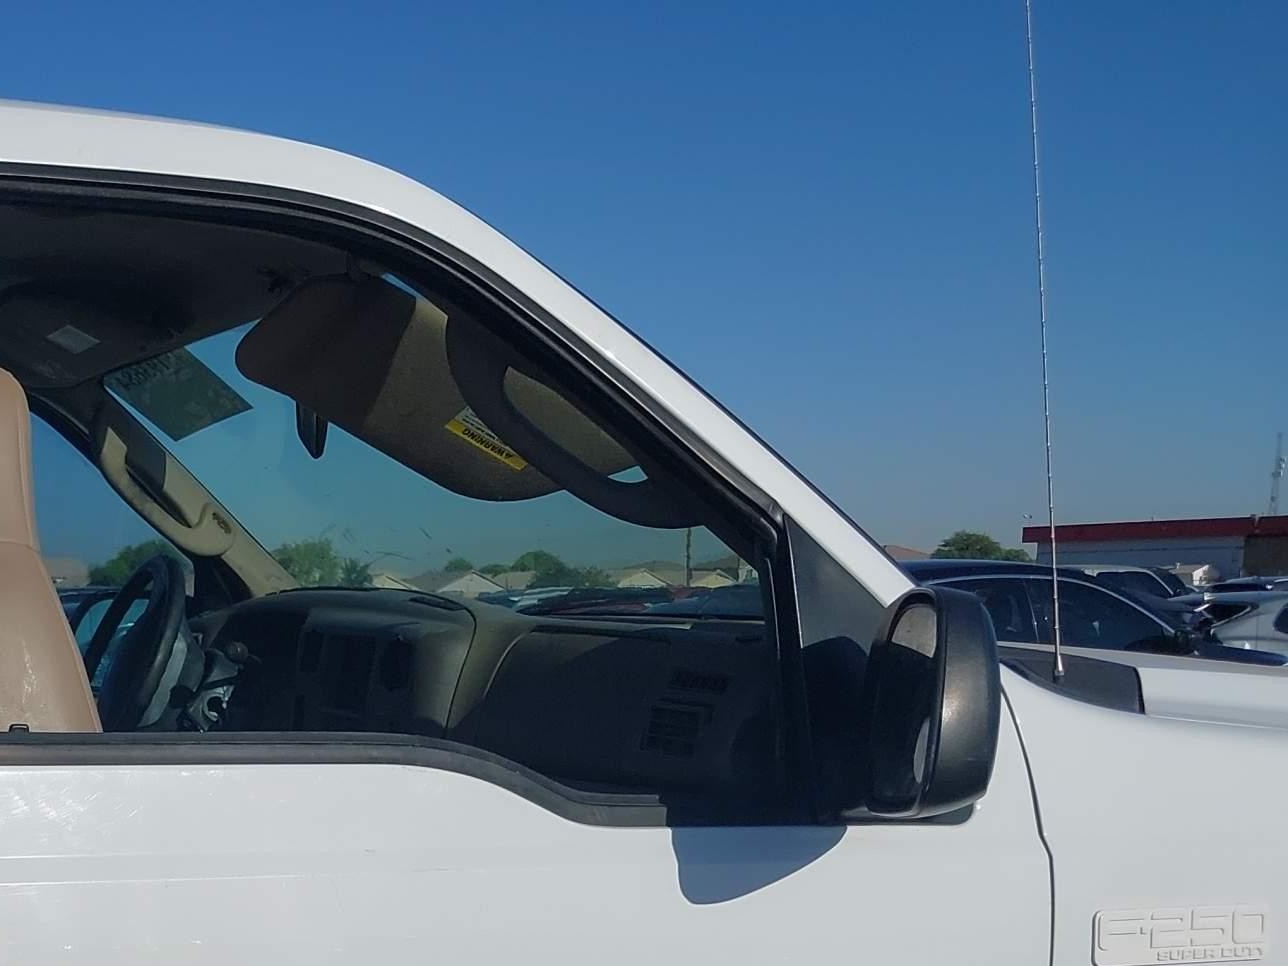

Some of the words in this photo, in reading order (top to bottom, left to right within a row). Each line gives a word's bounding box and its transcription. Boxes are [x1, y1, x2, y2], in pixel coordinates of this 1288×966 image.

[461, 427, 506, 457] WARNING
[1157, 949, 1218, 961] SUPER
[1221, 946, 1264, 958] DUTY
